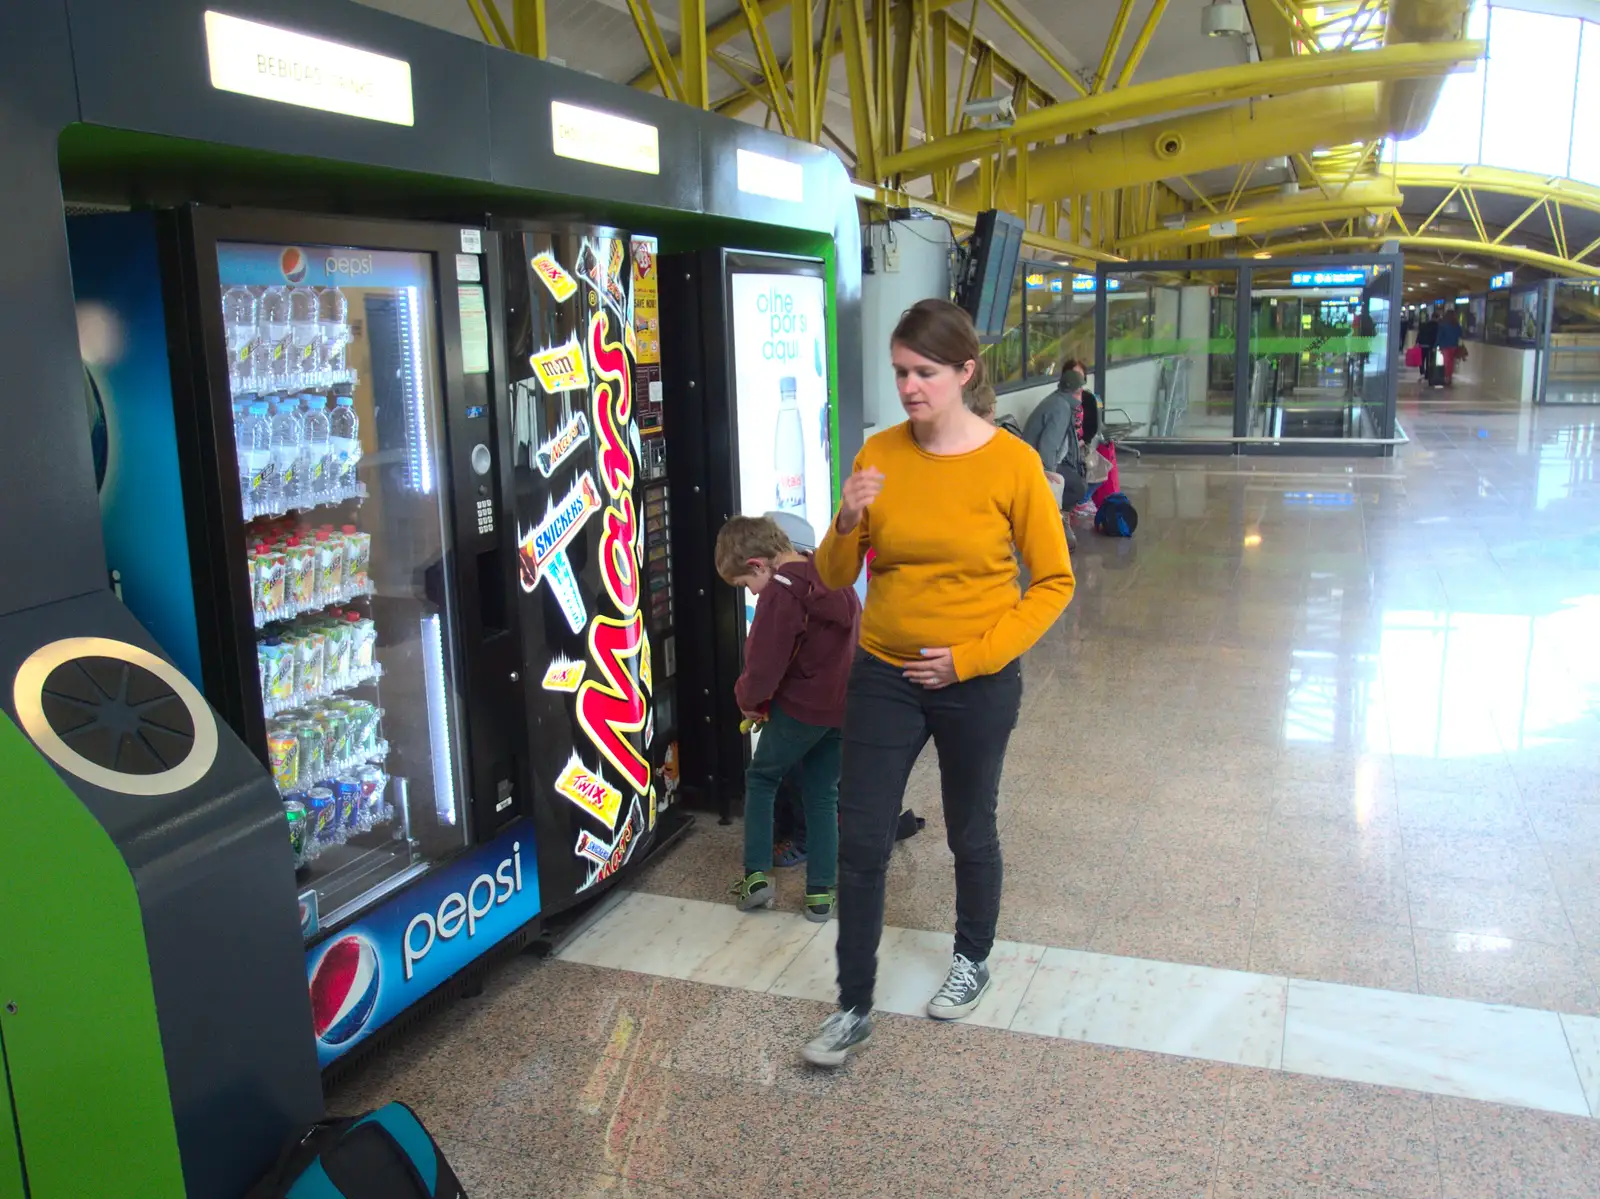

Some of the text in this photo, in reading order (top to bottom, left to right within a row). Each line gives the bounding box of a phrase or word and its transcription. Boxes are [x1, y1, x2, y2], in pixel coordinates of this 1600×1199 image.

[256, 53, 322, 86] BEBIDAS
[324, 253, 373, 277] pepsi
[757, 285, 793, 314] olhe
[771, 313, 797, 339] por
[762, 340, 799, 365] aqui
[535, 498, 584, 558] SNICKERS
[571, 774, 606, 810] TWIX
[403, 841, 523, 981] pepsi
